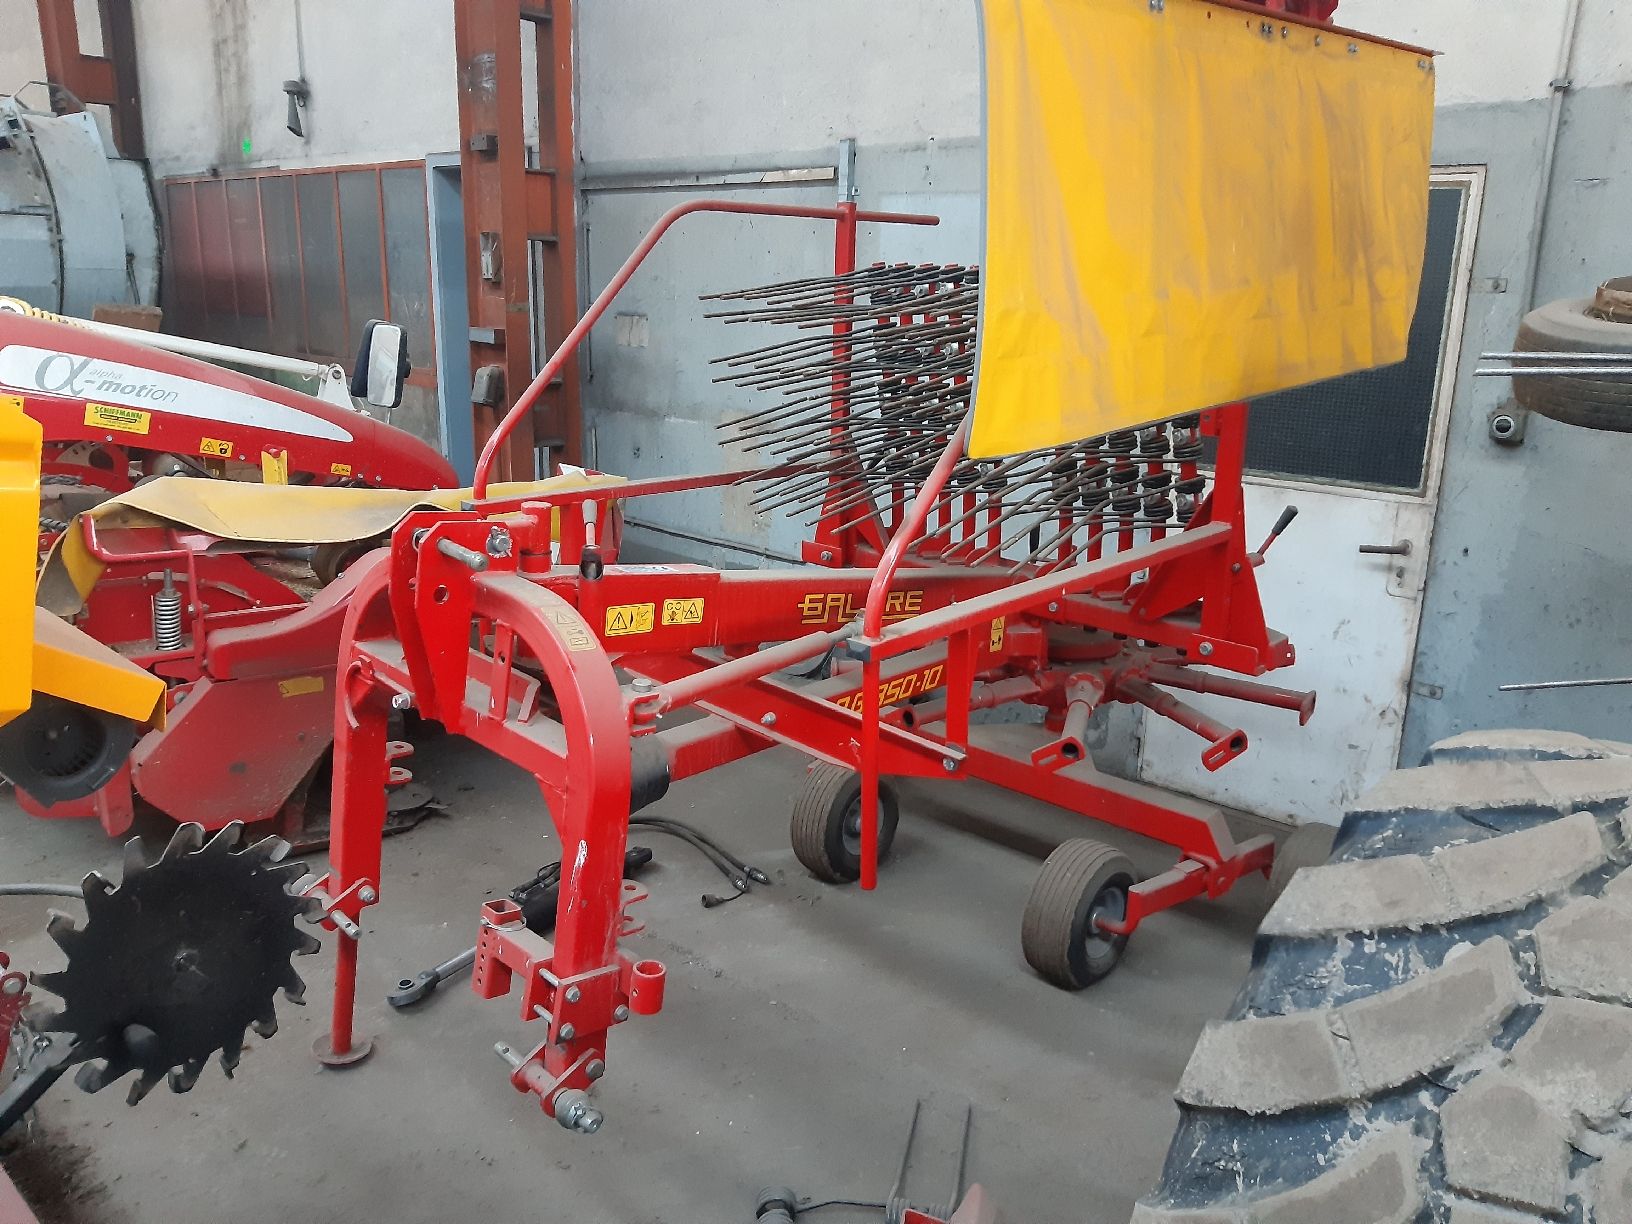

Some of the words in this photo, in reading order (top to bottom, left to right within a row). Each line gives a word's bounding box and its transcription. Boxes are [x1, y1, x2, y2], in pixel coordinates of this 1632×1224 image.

[89, 368, 124, 380] alpha
[94, 406, 143, 420] SCHIFFMANN
[798, 590, 924, 624] GALRE
